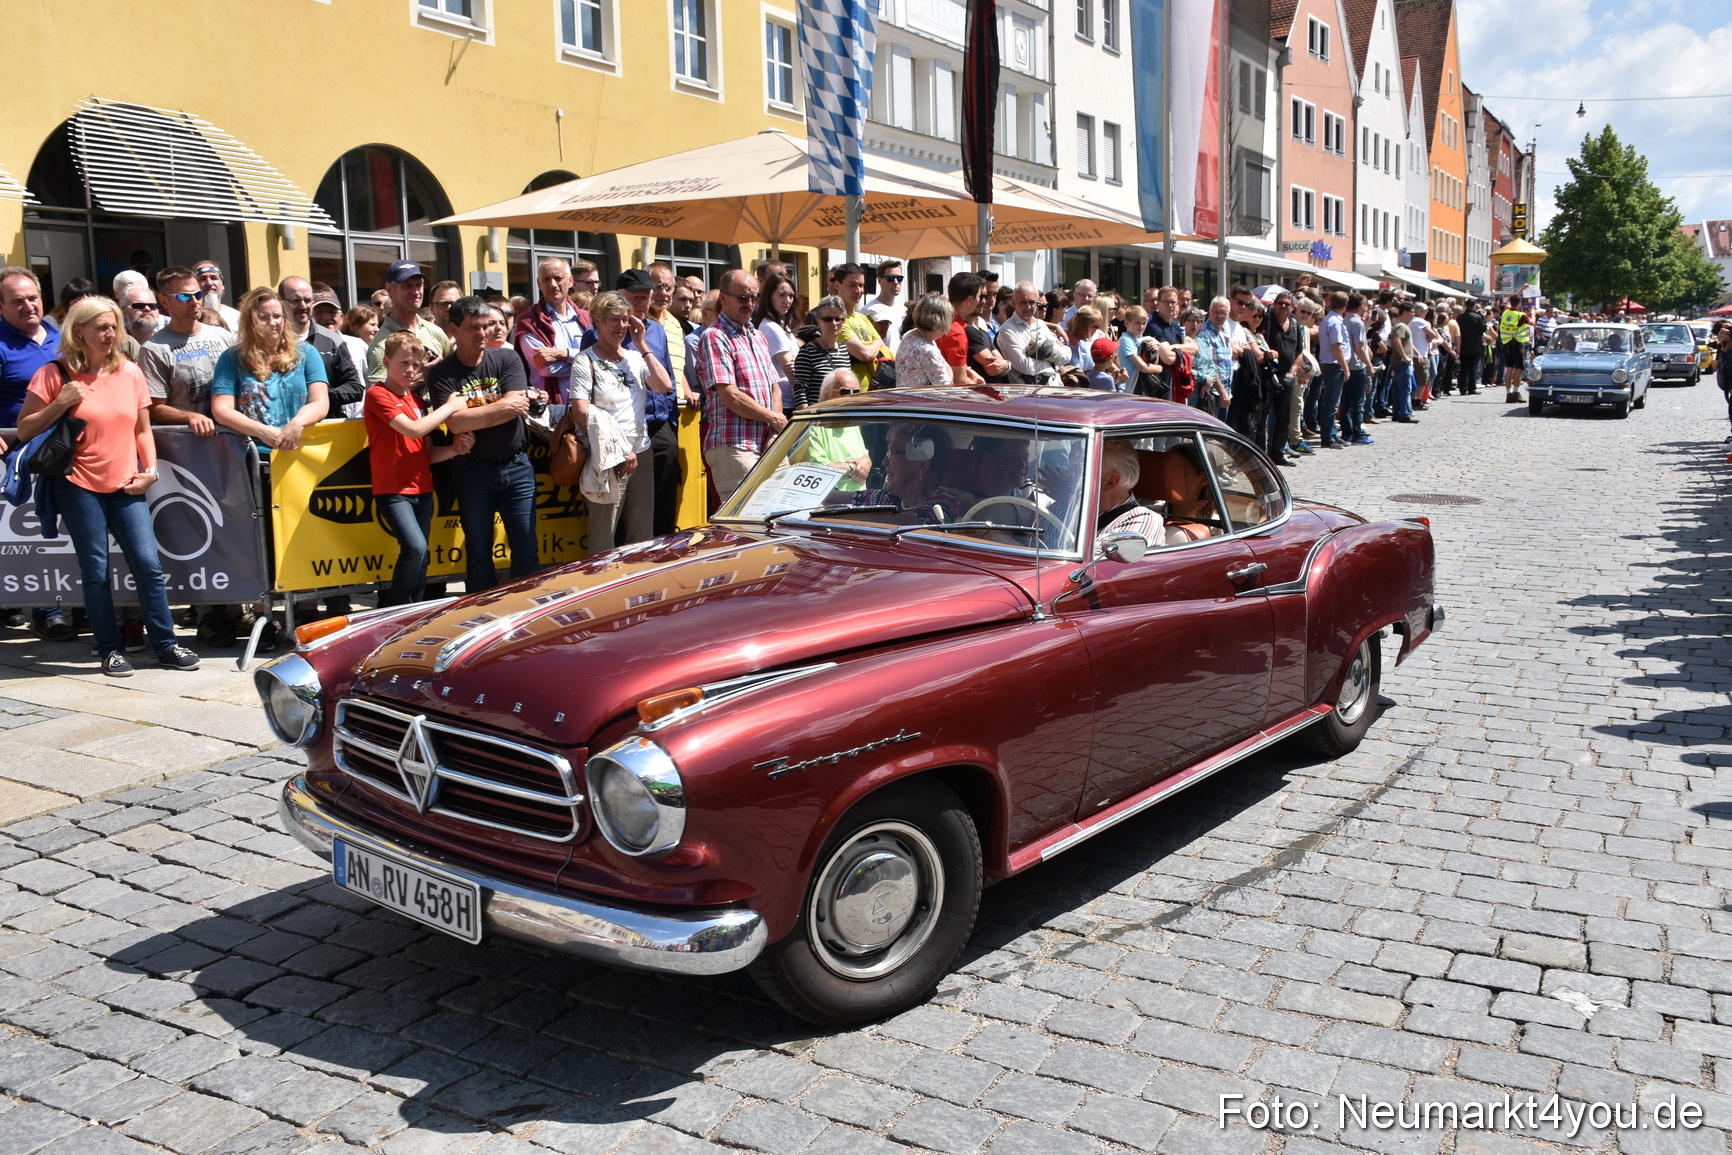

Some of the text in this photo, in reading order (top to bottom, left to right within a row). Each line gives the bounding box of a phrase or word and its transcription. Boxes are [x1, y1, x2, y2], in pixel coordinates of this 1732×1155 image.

[810, 266, 819, 278] 24
[203, 340, 222, 351] SAM
[793, 473, 823, 490] 656
[0, 545, 32, 555] UNN
[347, 850, 471, 932] AN RV 458H
